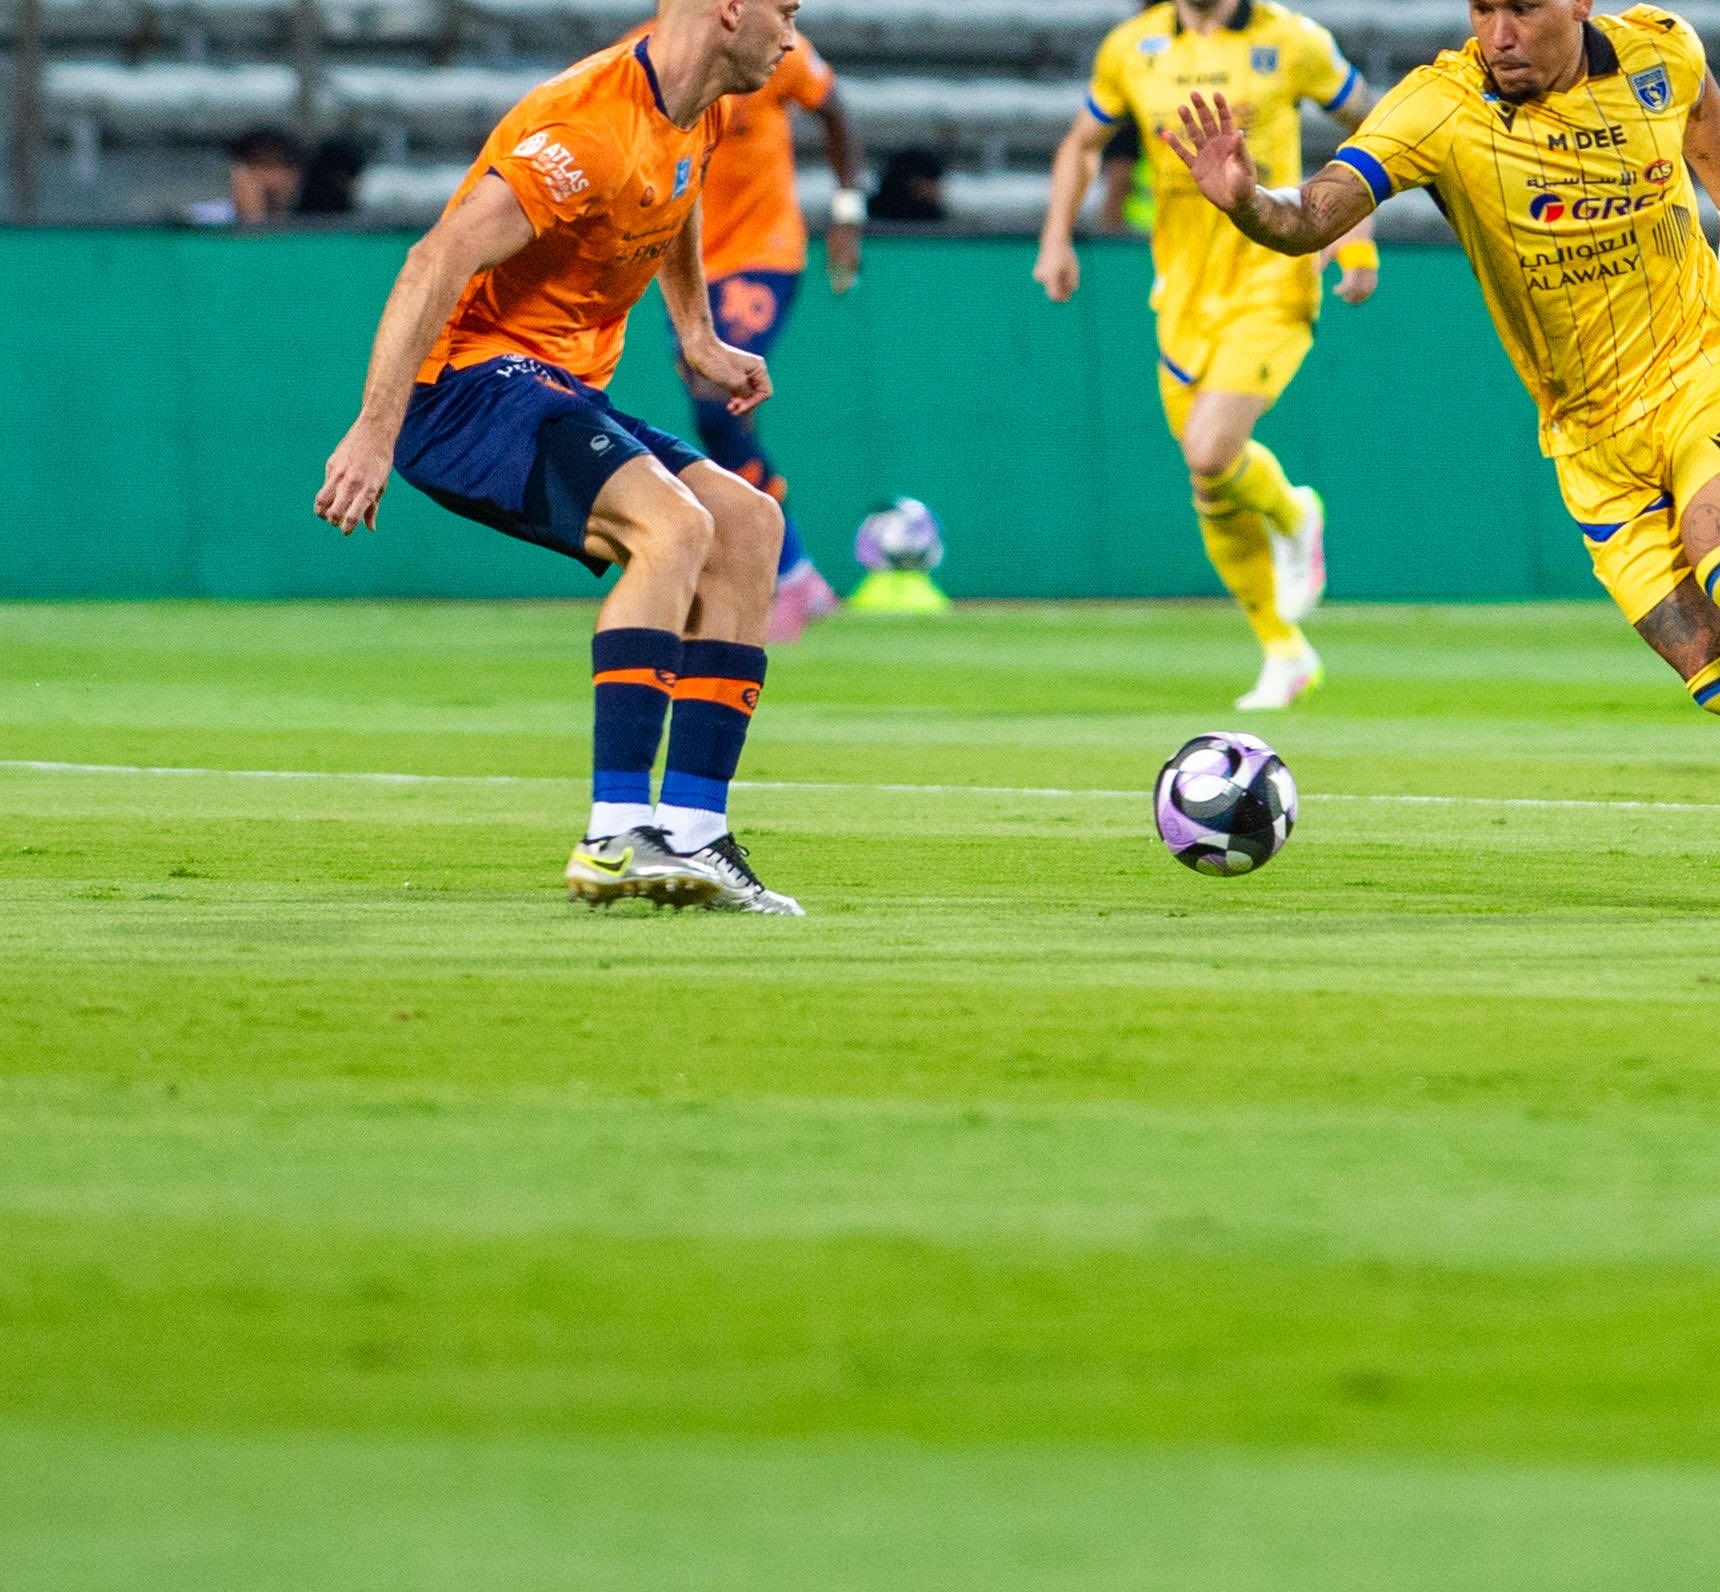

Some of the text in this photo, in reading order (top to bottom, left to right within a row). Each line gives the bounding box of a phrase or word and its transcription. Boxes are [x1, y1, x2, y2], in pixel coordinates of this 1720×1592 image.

[1575, 125, 1628, 151] DEE
[542, 142, 590, 193] ATLAS
[1527, 254, 1641, 292] ALAWALY
